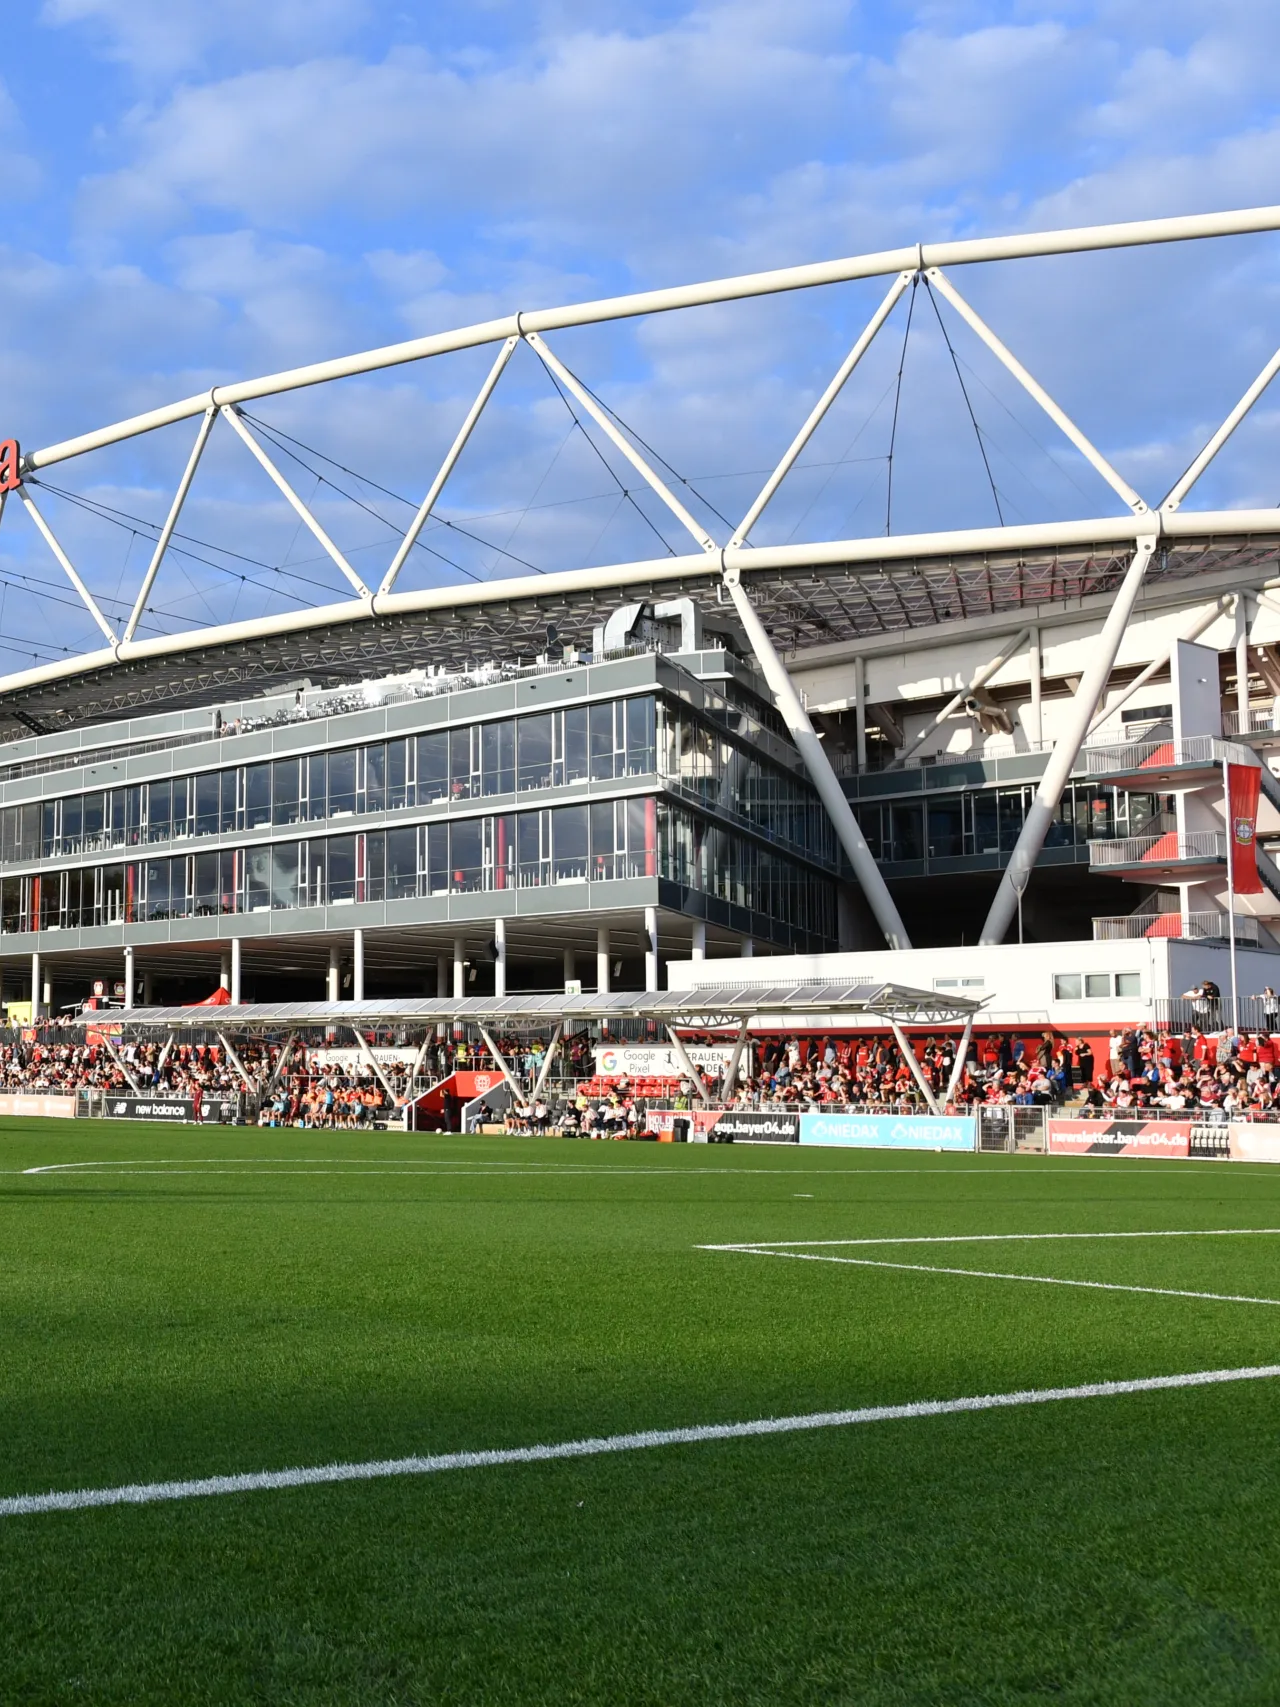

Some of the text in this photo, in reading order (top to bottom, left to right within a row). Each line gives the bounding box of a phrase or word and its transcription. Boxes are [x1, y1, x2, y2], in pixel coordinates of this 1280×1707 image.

[326, 1053, 348, 1063] Google
[624, 1050, 656, 1062] Google
[629, 1063, 650, 1073] Pixel
[135, 1103, 185, 1115] new balance
[828, 1123, 879, 1138] NIEDAX
[909, 1124, 963, 1140] NIEDAX
[1051, 1131, 1188, 1147] newsletter.bayer04.de
